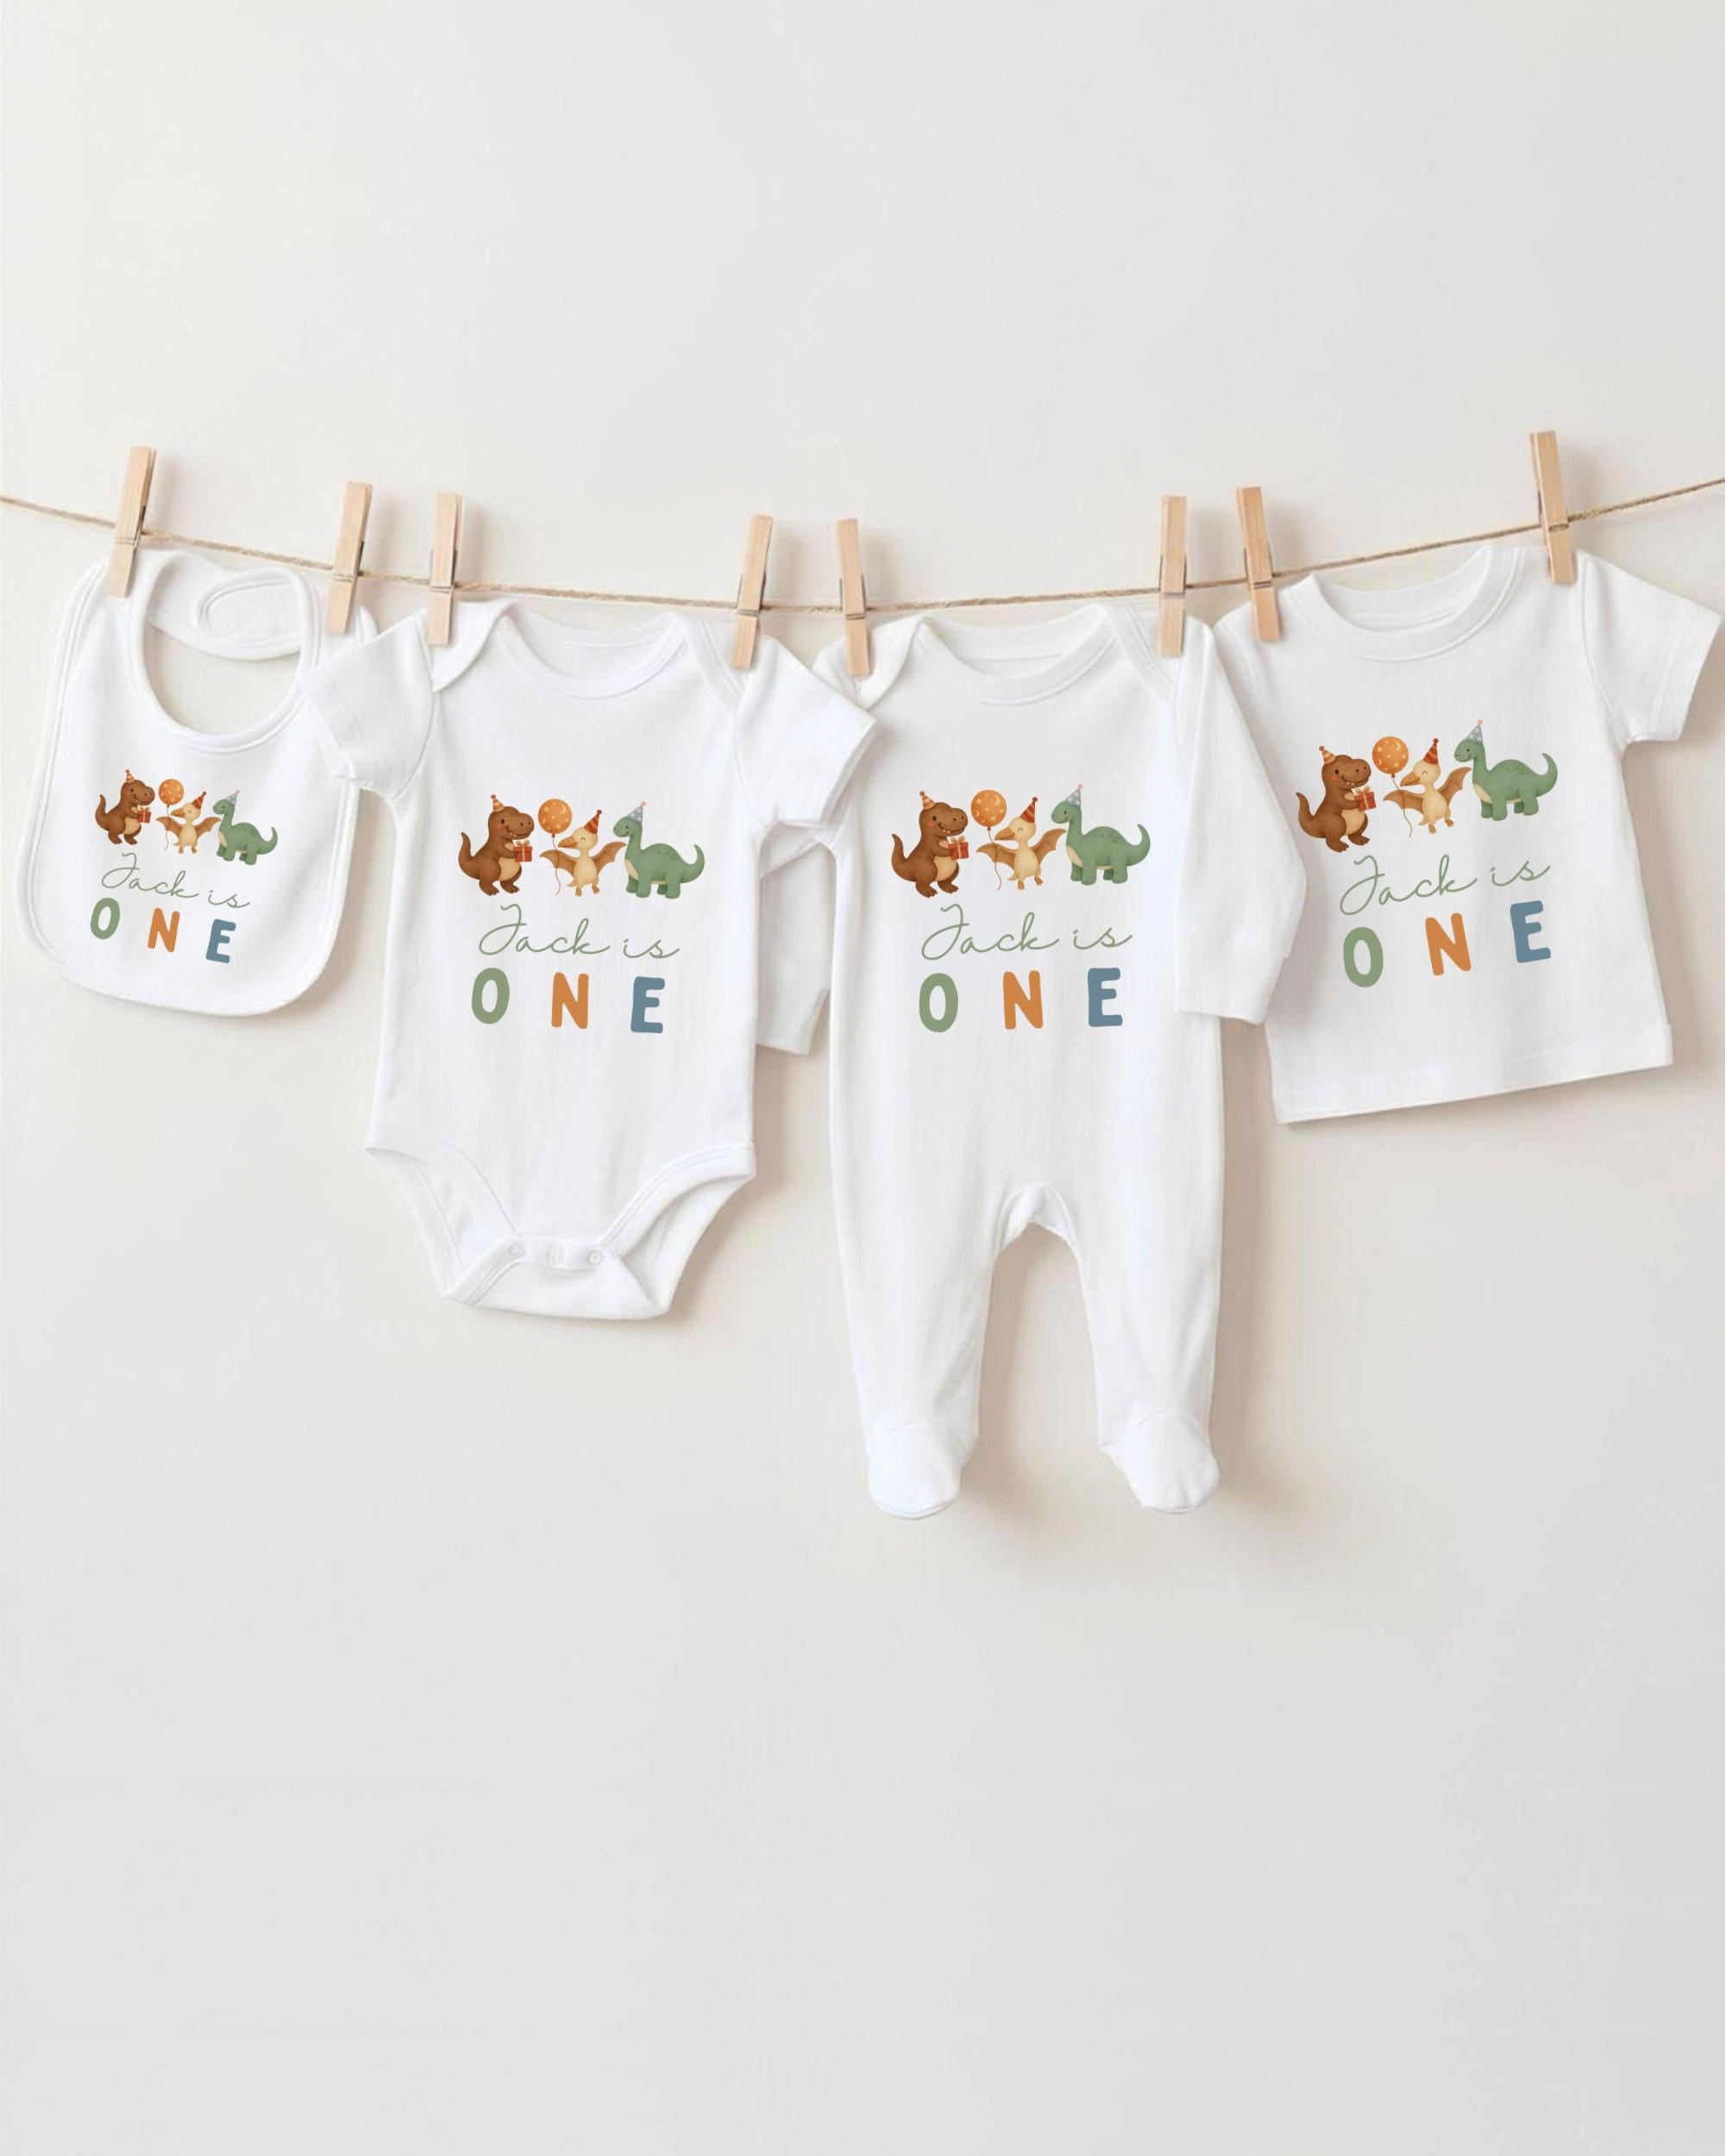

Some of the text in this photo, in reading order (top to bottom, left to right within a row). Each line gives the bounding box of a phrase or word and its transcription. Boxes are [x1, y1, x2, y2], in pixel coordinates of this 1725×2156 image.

[101, 852, 251, 909] Jack is
[1339, 855, 1552, 916] Jack is
[91, 897, 236, 964] ONE
[479, 903, 681, 959] Jack is
[921, 903, 1133, 961] Jack is
[1343, 899, 1552, 988] ONE
[471, 967, 666, 1034] ONE
[919, 967, 1123, 1033] ONE
